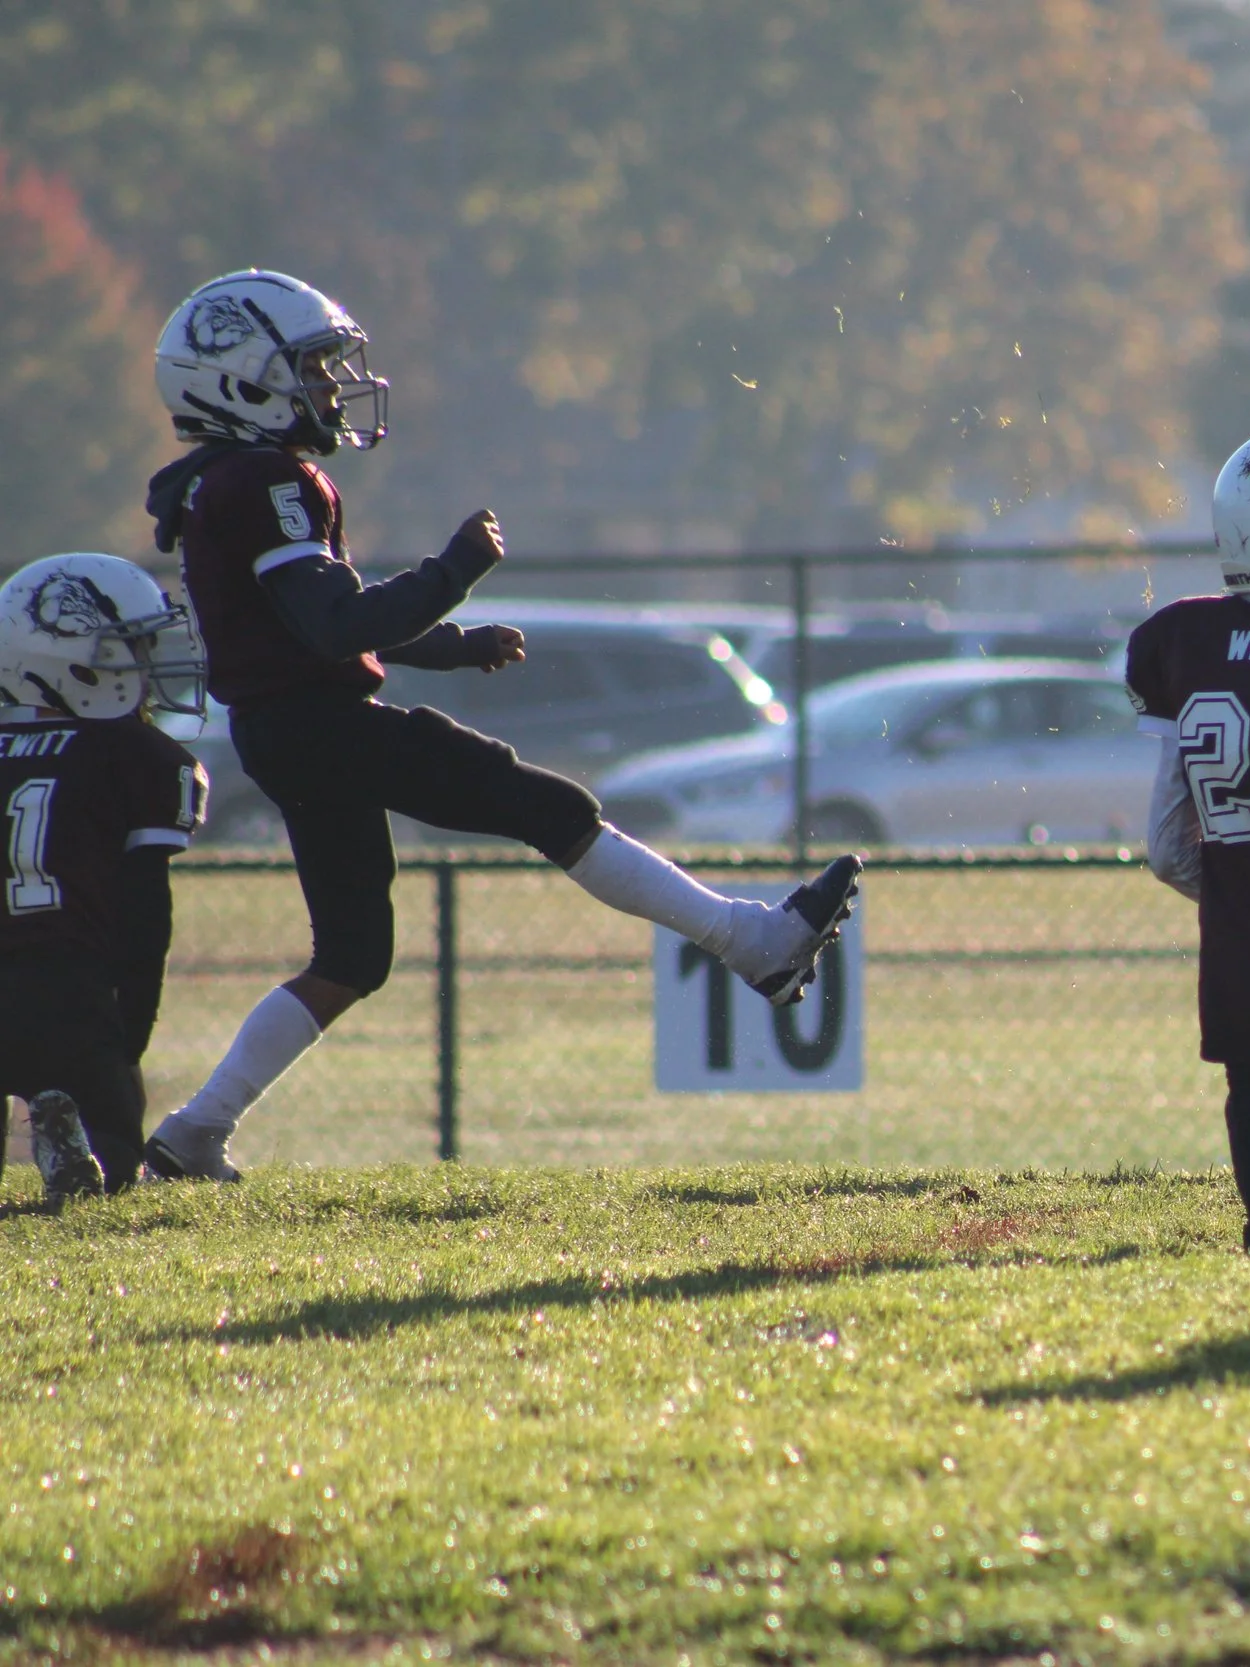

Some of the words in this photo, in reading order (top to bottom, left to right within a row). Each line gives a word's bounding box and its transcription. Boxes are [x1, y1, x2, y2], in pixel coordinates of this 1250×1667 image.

[268, 481, 312, 541] 5
[6, 779, 62, 915] 1
[678, 930, 847, 1077] 10
